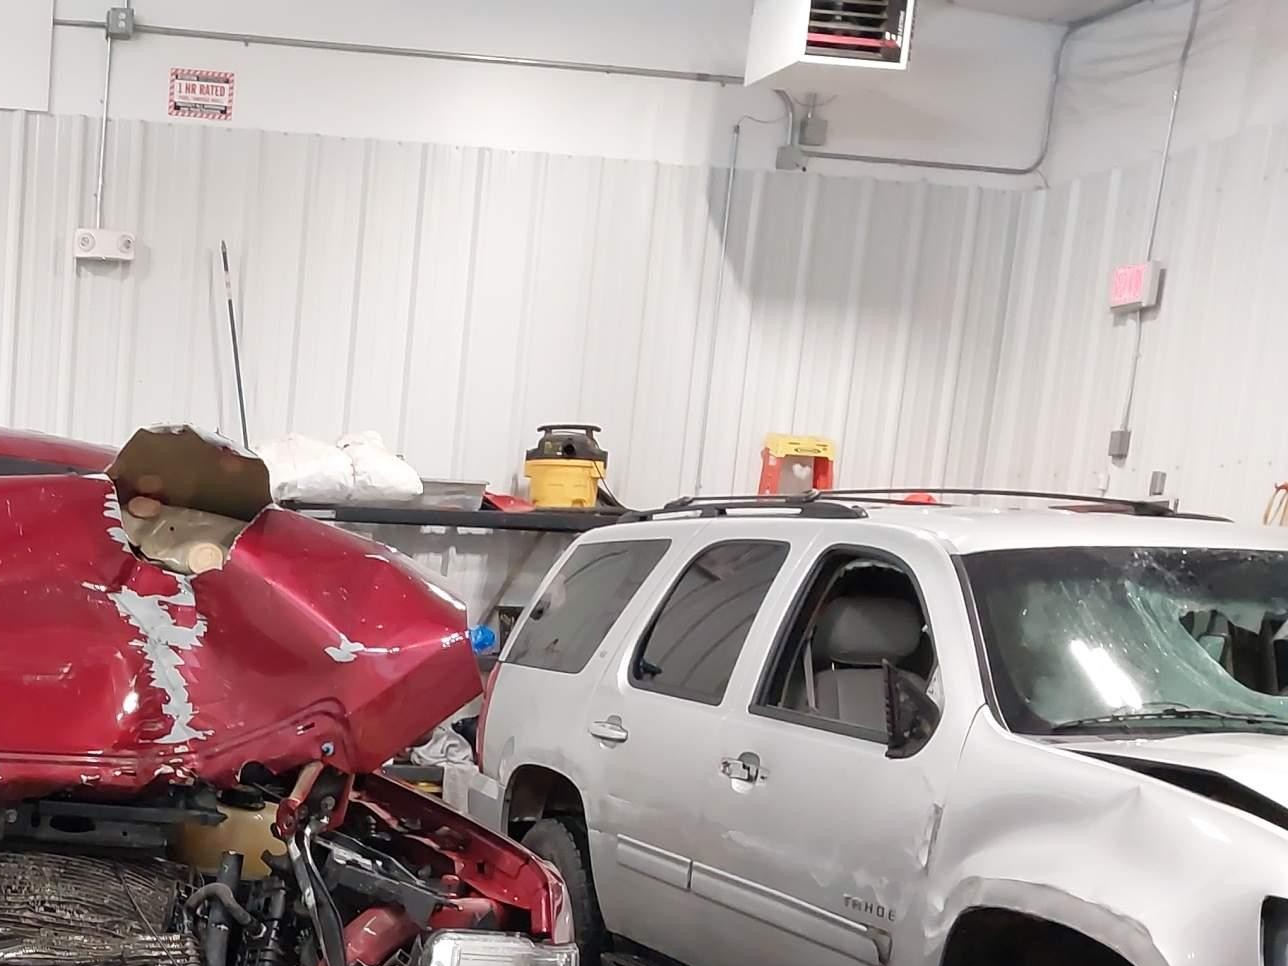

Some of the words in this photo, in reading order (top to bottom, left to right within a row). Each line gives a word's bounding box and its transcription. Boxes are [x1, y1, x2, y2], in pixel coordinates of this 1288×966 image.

[185, 83, 197, 95] HR
[199, 84, 226, 97] RATED
[843, 895, 895, 922] TAHOE
